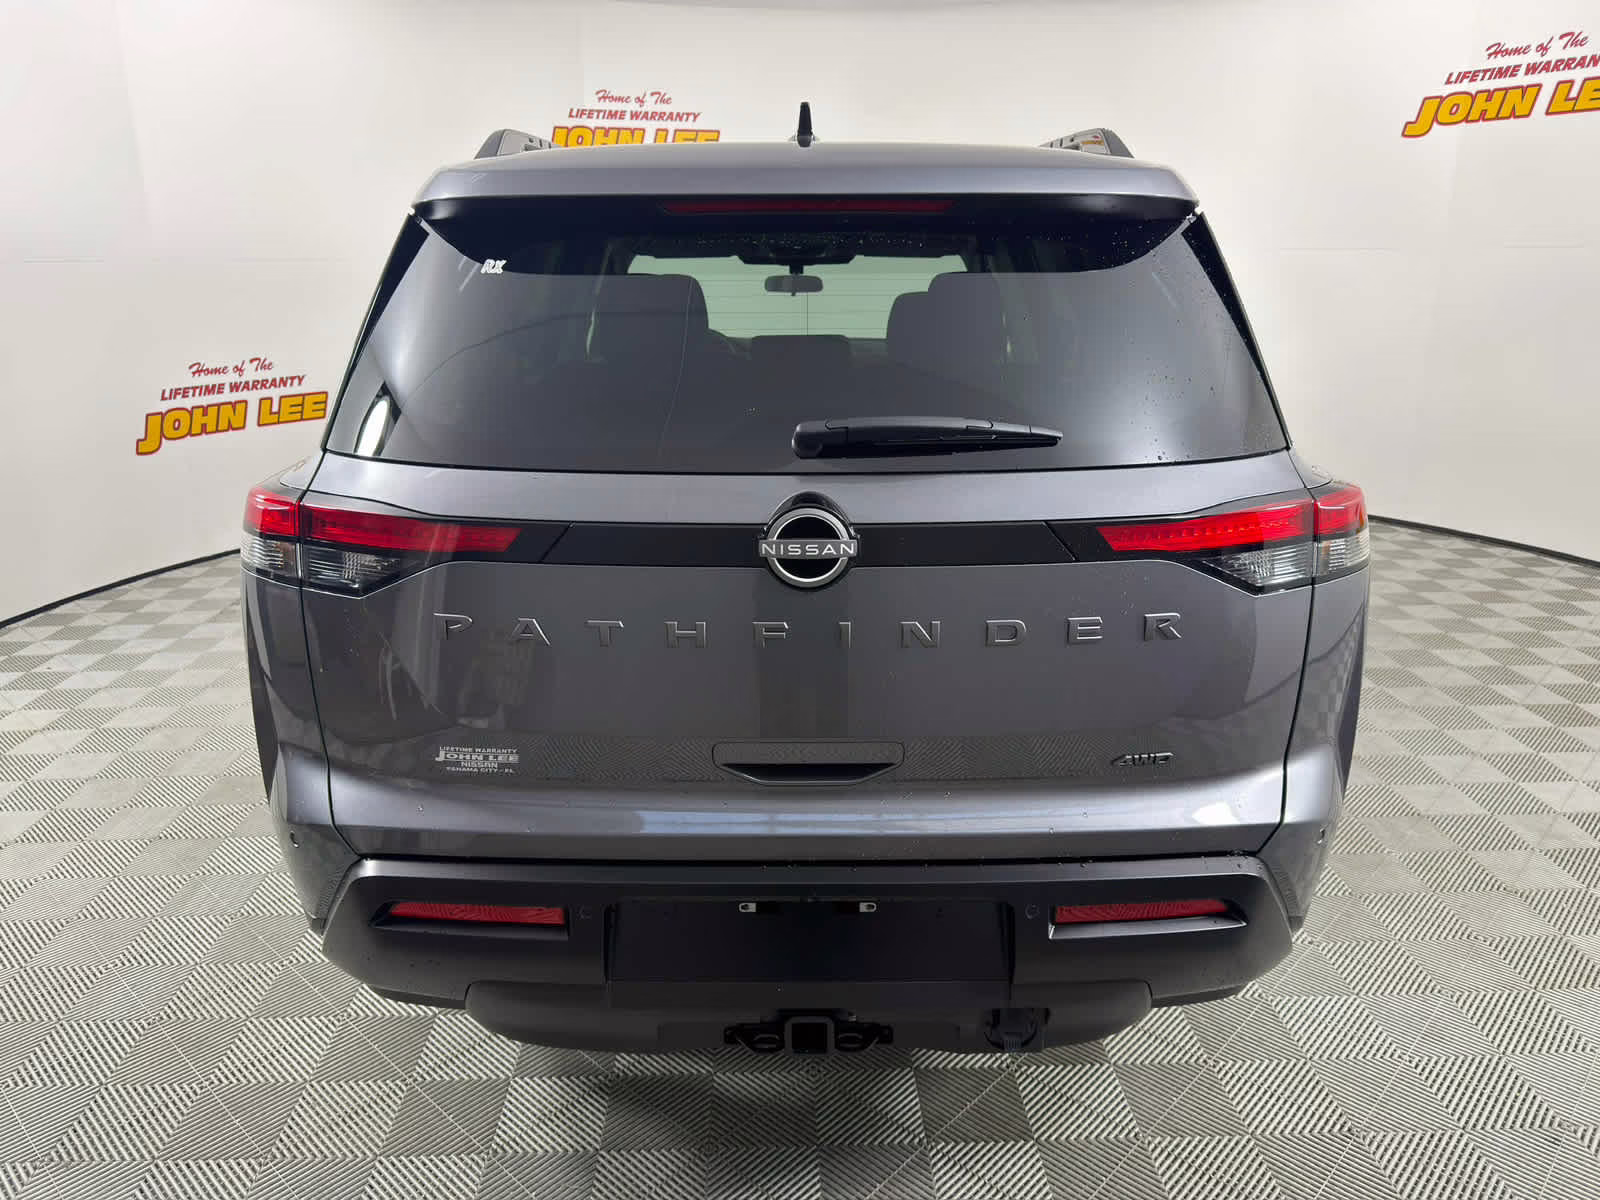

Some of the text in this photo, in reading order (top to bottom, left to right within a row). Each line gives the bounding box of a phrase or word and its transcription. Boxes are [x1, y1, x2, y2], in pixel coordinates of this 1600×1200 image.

[1485, 30, 1589, 60] Home of The
[1444, 64, 1522, 85] LIFETIME
[595, 89, 672, 107] Home of The
[568, 107, 700, 122] LIFETIME WARRANTY
[1401, 83, 1543, 138] JOHN
[188, 357, 274, 377] Home of The
[160, 375, 305, 401] LIFETIME WARRANTY
[136, 391, 329, 456] JOHN LEE
[761, 543, 855, 556] NISSAN
[433, 611, 1183, 648] PATHFINDER
[435, 750, 519, 762] JOHN LEE
